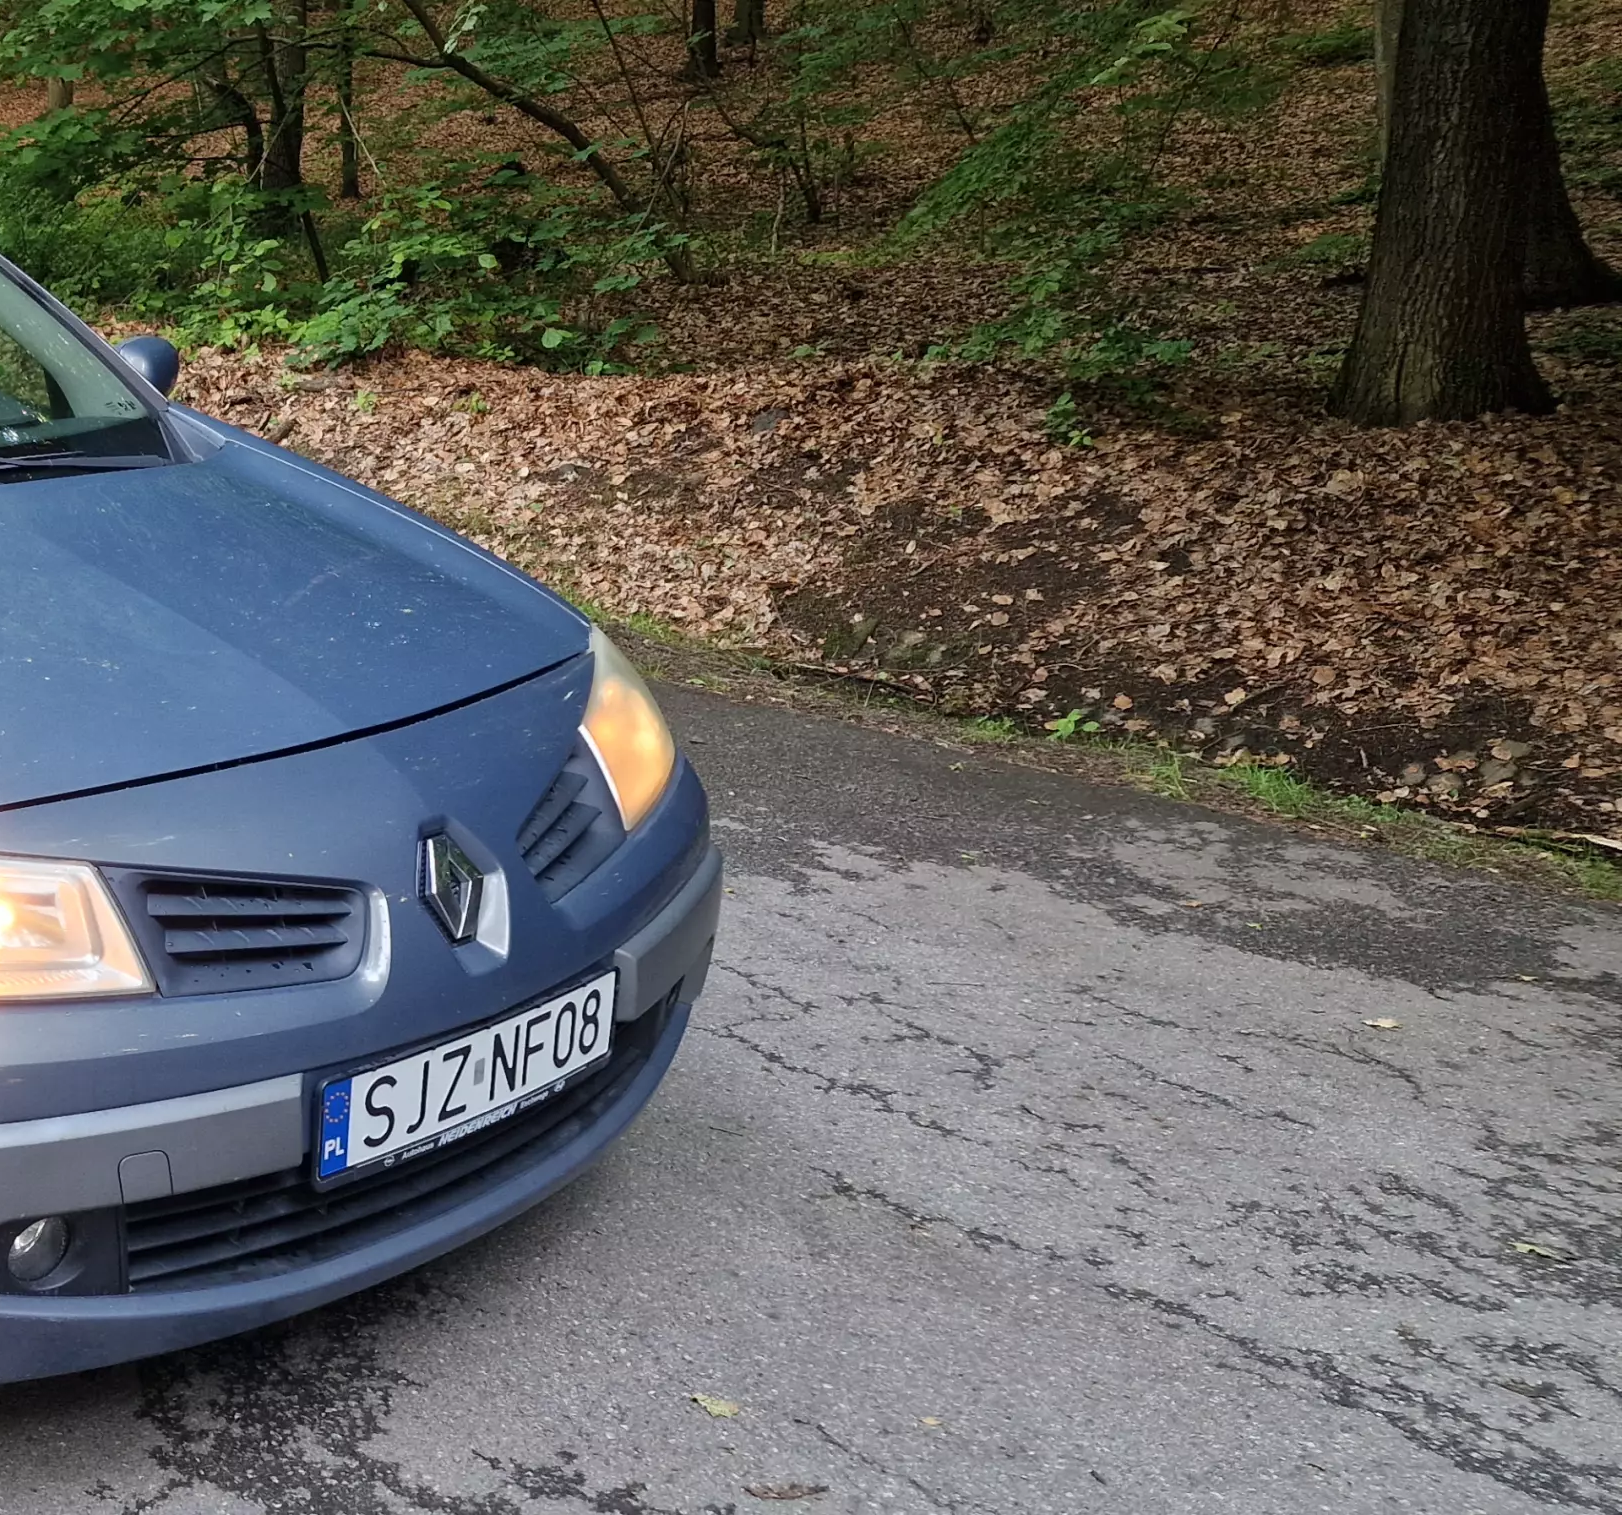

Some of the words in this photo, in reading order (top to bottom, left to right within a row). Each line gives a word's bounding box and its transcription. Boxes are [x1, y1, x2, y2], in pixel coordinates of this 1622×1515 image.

[363, 1044, 472, 1148] SJZ
[489, 989, 601, 1101] NF08
[323, 1137, 345, 1161] PL
[401, 1141, 435, 1161] Autohaus
